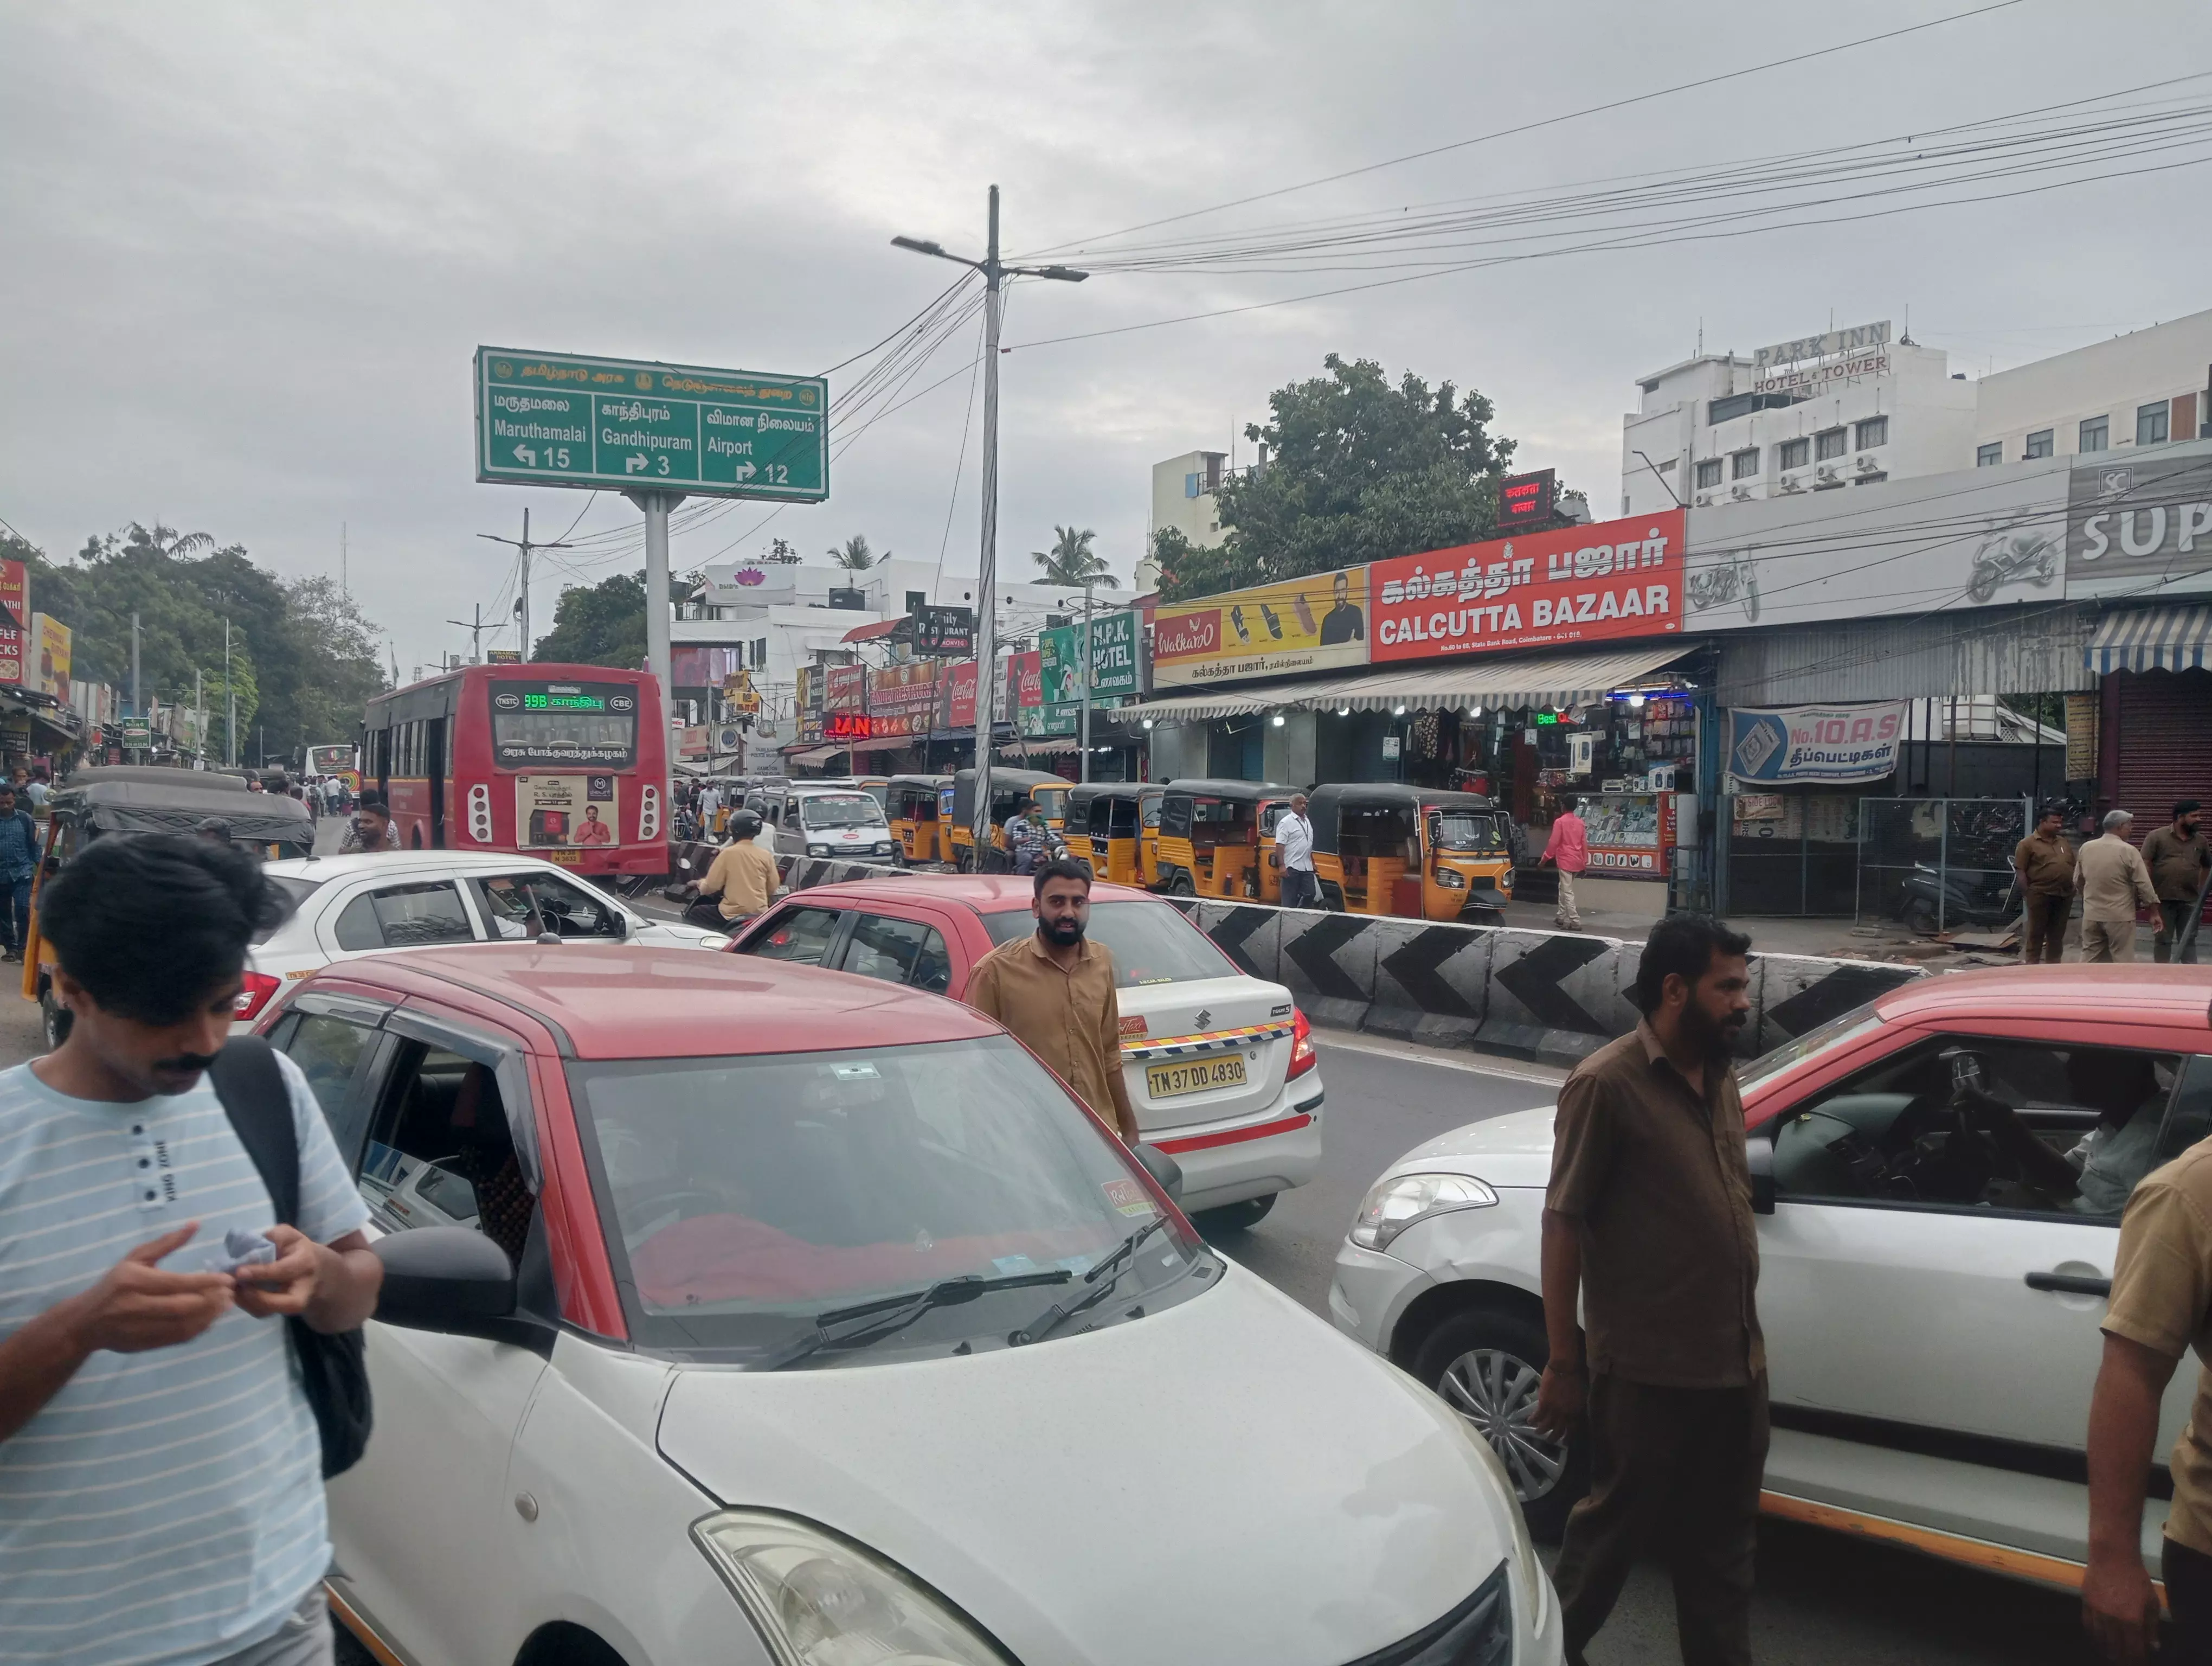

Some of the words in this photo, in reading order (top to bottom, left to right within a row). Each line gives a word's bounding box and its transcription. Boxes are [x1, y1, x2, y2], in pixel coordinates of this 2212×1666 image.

[1758, 335, 1828, 367] PARK
[1838, 324, 1885, 350] INN
[1754, 373, 1810, 394] HOTEL
[1822, 356, 1887, 380] TOWER
[494, 395, 570, 413] மருதமலை
[602, 401, 670, 424] காந்திபுரம்
[494, 419, 586, 443] Maruthamalai
[707, 408, 755, 428] விமான
[757, 412, 815, 434] நிலையம்
[602, 427, 692, 452] Gandhipuram
[708, 436, 753, 458] Airport
[543, 447, 570, 469] 15
[657, 455, 670, 476] 3
[764, 463, 788, 484] 12
[1381, 558, 1534, 605] கல்கத்தா
[1548, 527, 1668, 581] பஜார்
[1379, 603, 1522, 645] CALCUTTA
[1533, 584, 1669, 627] BAZAAR
[918, 622, 969, 636] RSTURANT
[1094, 620, 1129, 646] M.P.K.
[1092, 645, 1132, 670] HOTEL
[1192, 663, 1236, 678] கல்கத்தா
[1538, 713, 1557, 725] Best
[502, 748, 526, 757] அரசு
[528, 746, 628, 760] போக்குவரத்துக்கழகம்
[1789, 742, 1892, 768] தீப்பெட்டிகள்
[1152, 1072, 1172, 1093] TN
[1173, 1068, 1188, 1090] 37
[1191, 1066, 1208, 1087] DD
[1212, 1061, 1243, 1084] 4830
[154, 1140, 170, 1168] ZONE
[162, 1173, 176, 1202] KING
